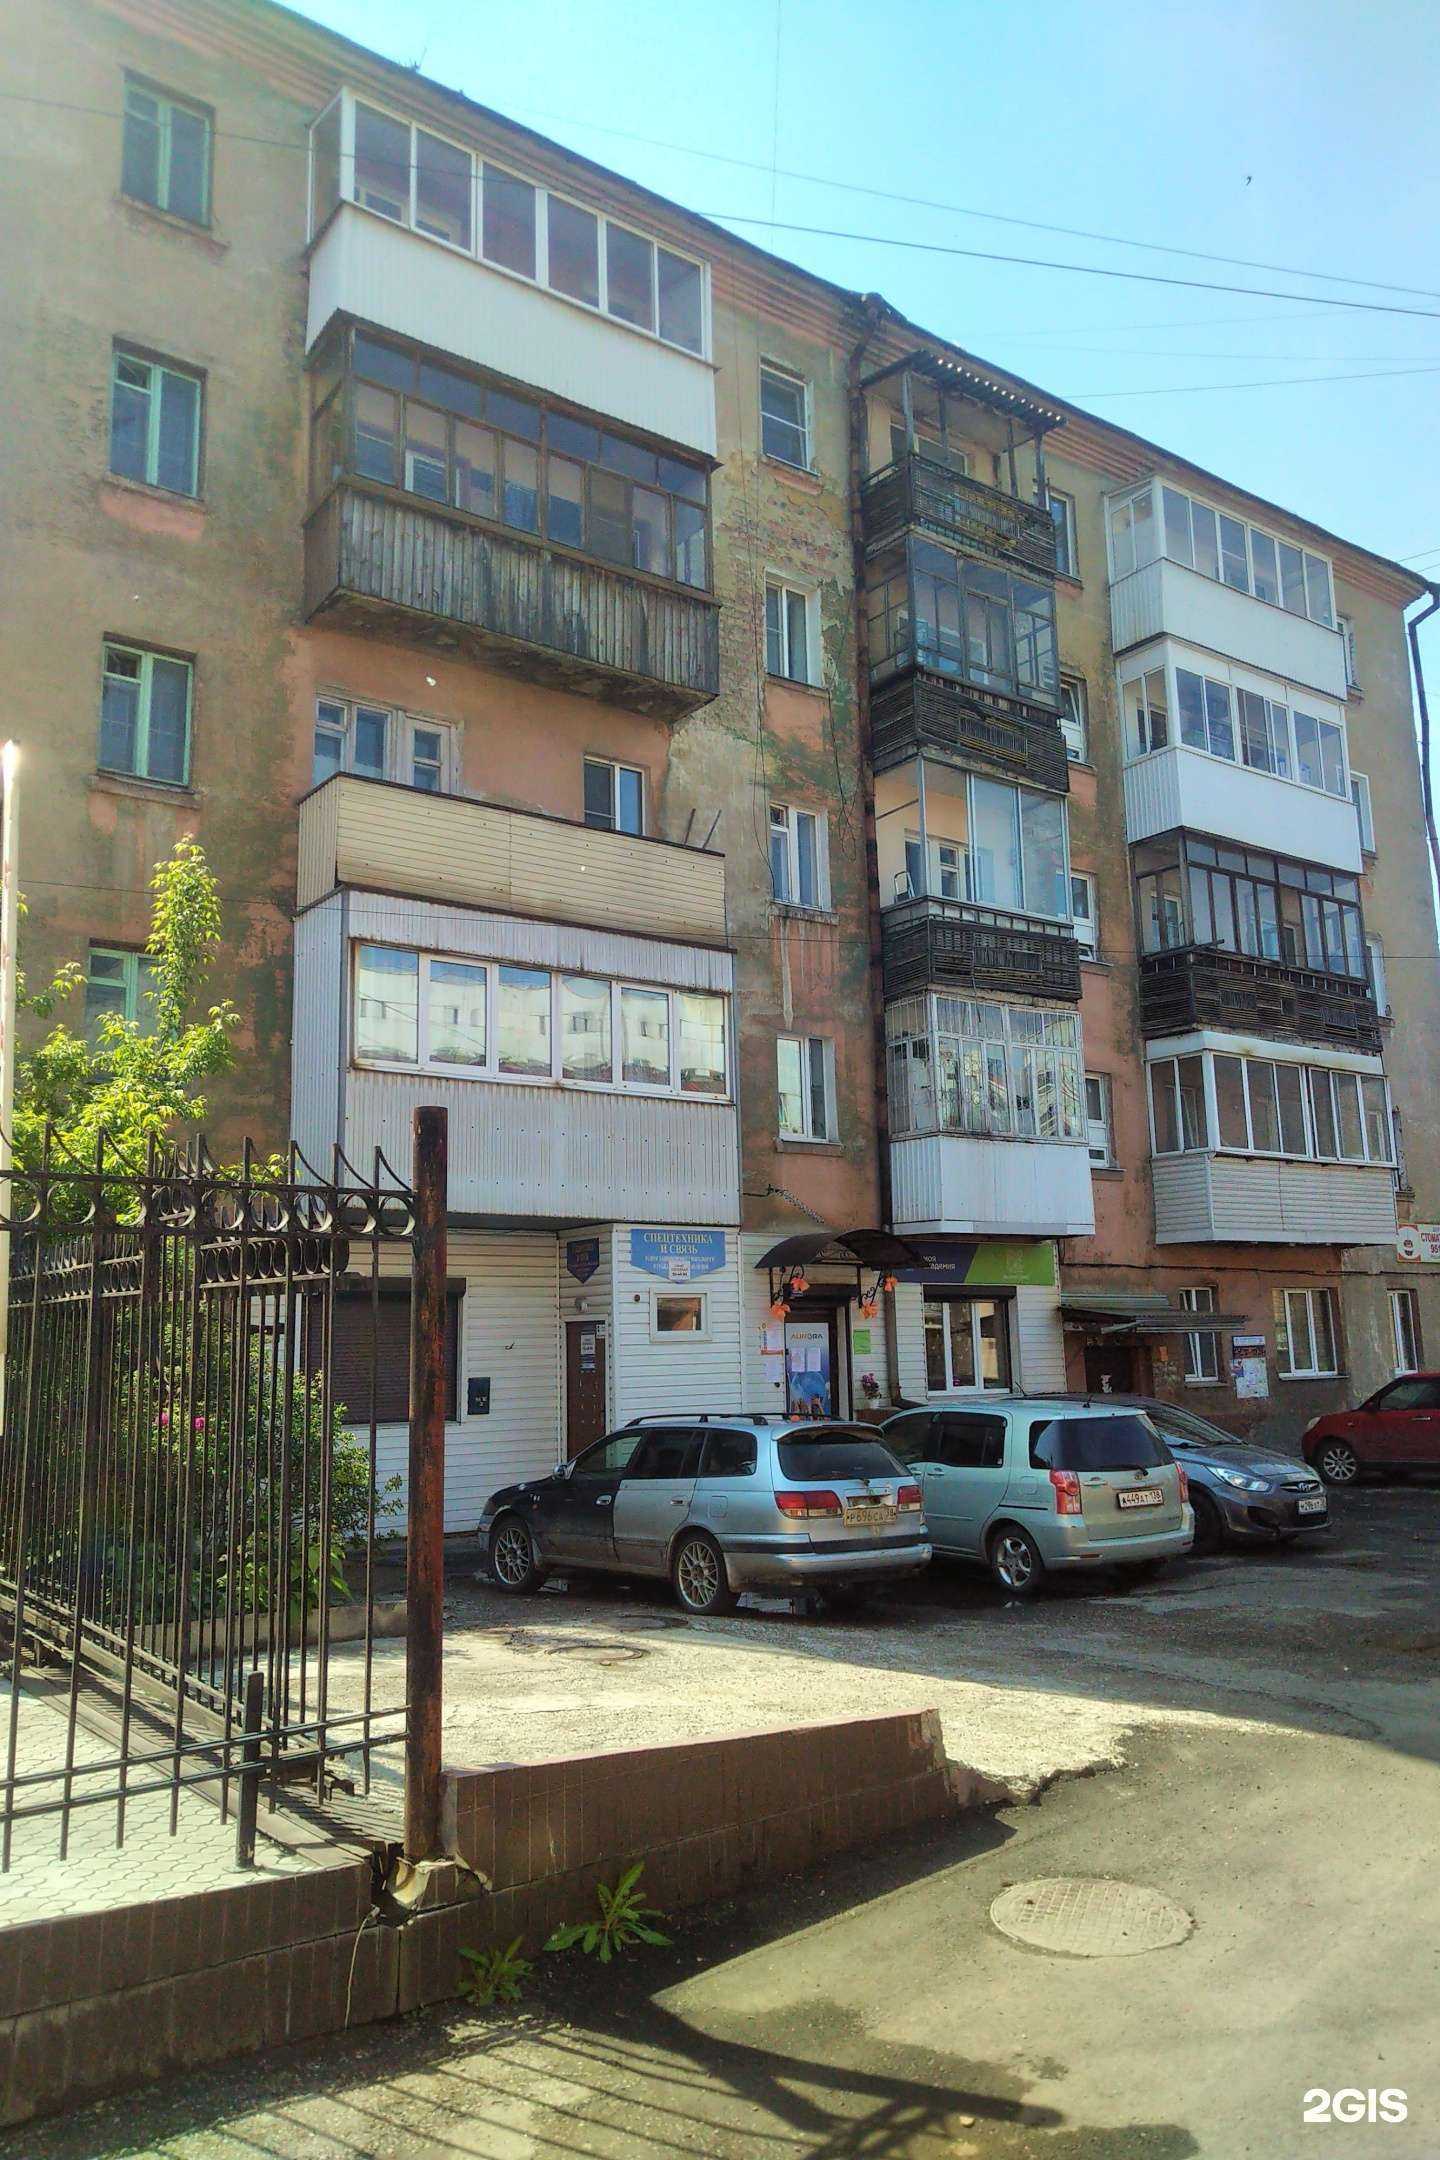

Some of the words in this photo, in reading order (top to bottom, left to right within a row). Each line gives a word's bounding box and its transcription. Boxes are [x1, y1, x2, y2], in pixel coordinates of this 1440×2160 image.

[643, 1232, 713, 1244] СПЕЦТЕХНИКА
[1420, 1232, 1440, 1243] СТОМА
[660, 1245, 668, 1254] И
[669, 1243, 698, 1254] СВЯЗЬ
